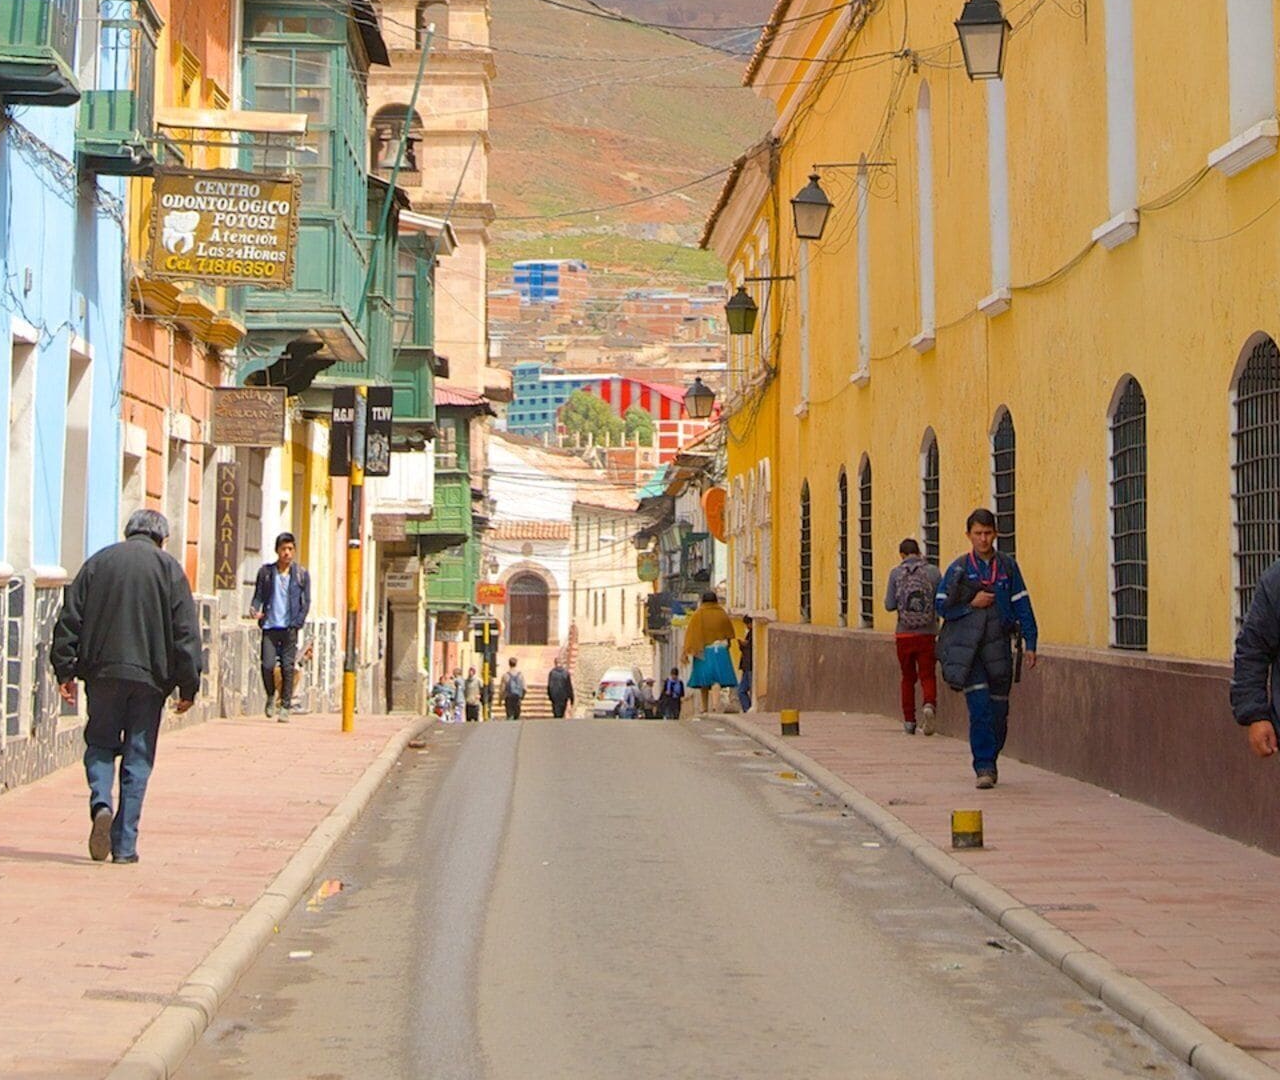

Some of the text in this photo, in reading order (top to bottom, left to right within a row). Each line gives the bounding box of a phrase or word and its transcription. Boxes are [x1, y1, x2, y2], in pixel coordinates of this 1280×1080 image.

[194, 180, 260, 197] CENTRO
[162, 194, 290, 216] ODONTOLOGICO
[196, 243, 225, 258] Las
[219, 466, 237, 573] NOTARIA
